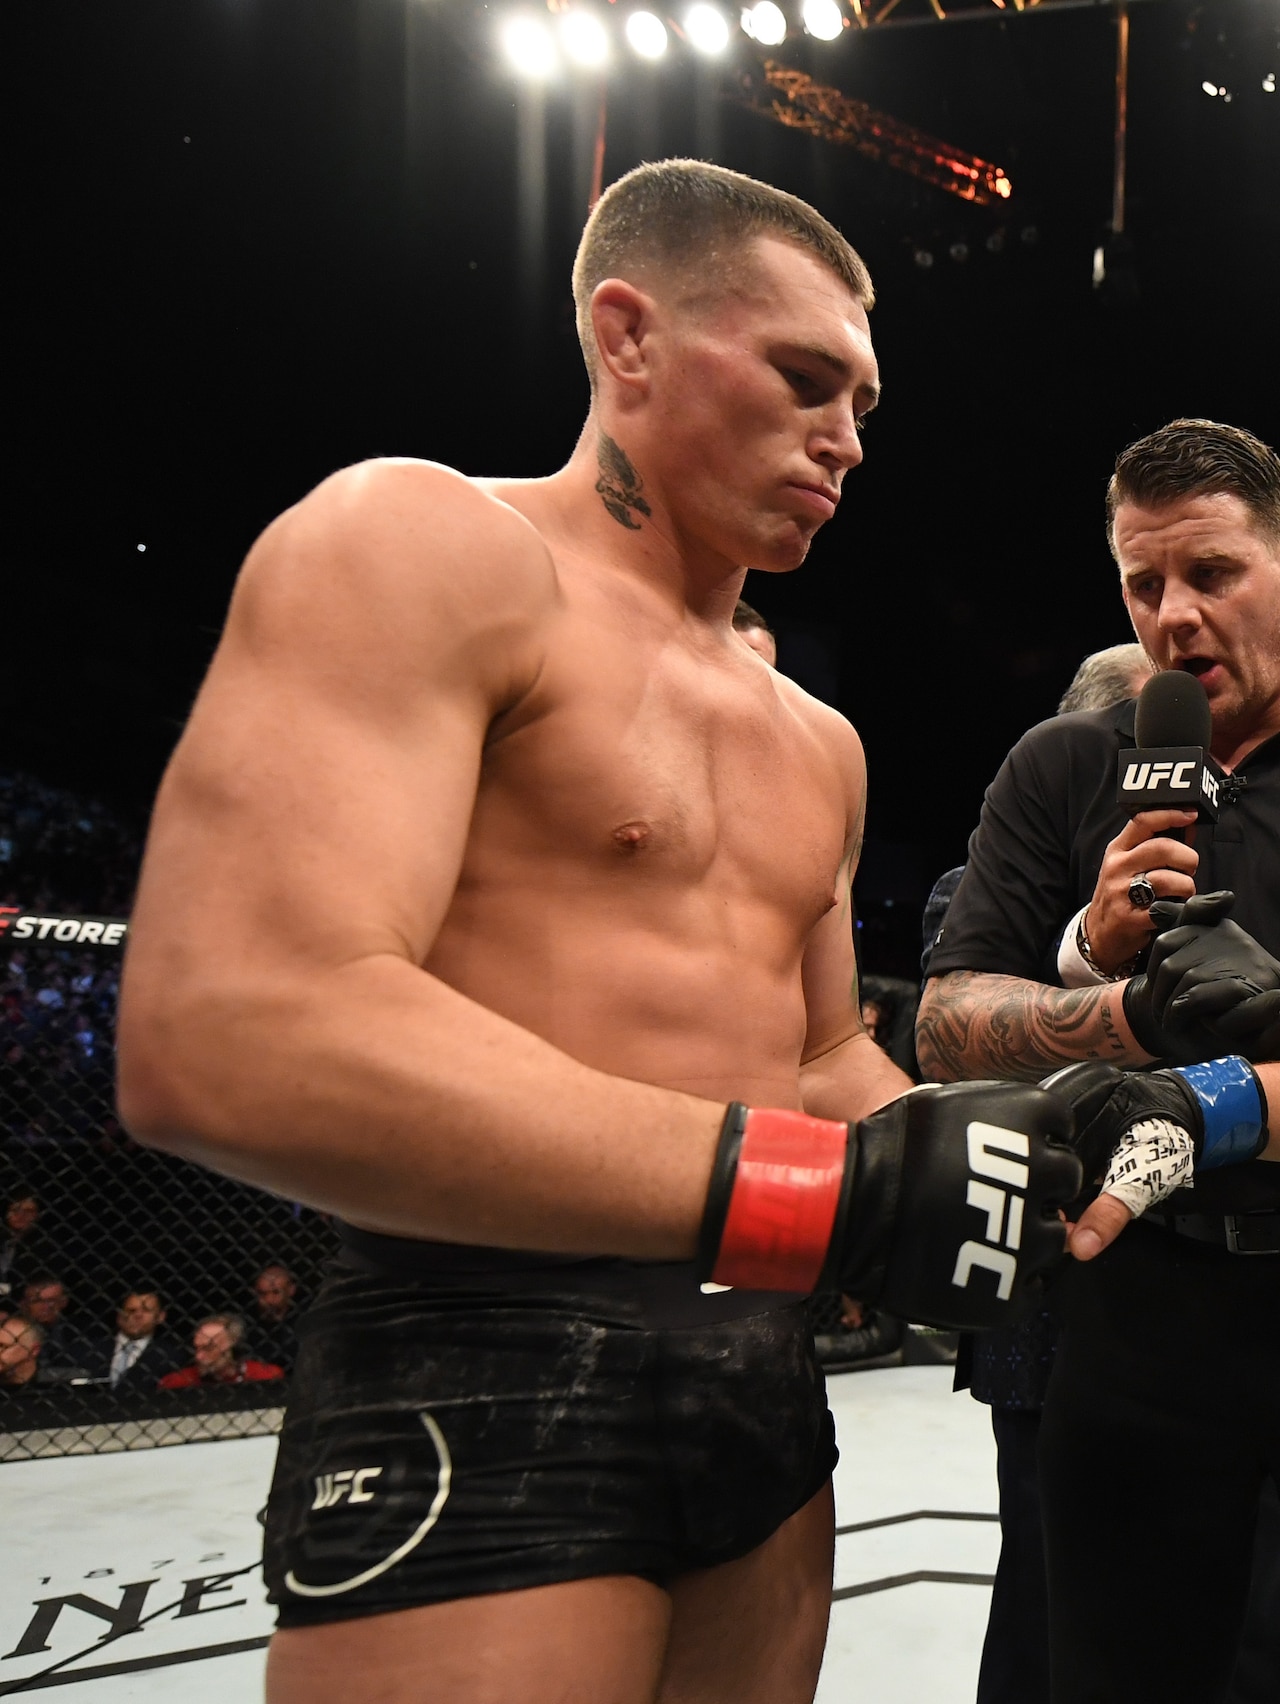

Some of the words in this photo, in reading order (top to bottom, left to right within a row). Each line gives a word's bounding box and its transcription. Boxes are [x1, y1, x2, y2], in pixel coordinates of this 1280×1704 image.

[1122, 761, 1197, 791] UFC
[1201, 765, 1220, 808] UFC
[11, 916, 127, 946] STORE
[1106, 1158, 1138, 1188] UFC
[951, 1121, 1030, 1301] UFC
[311, 1466, 384, 1511] UFC
